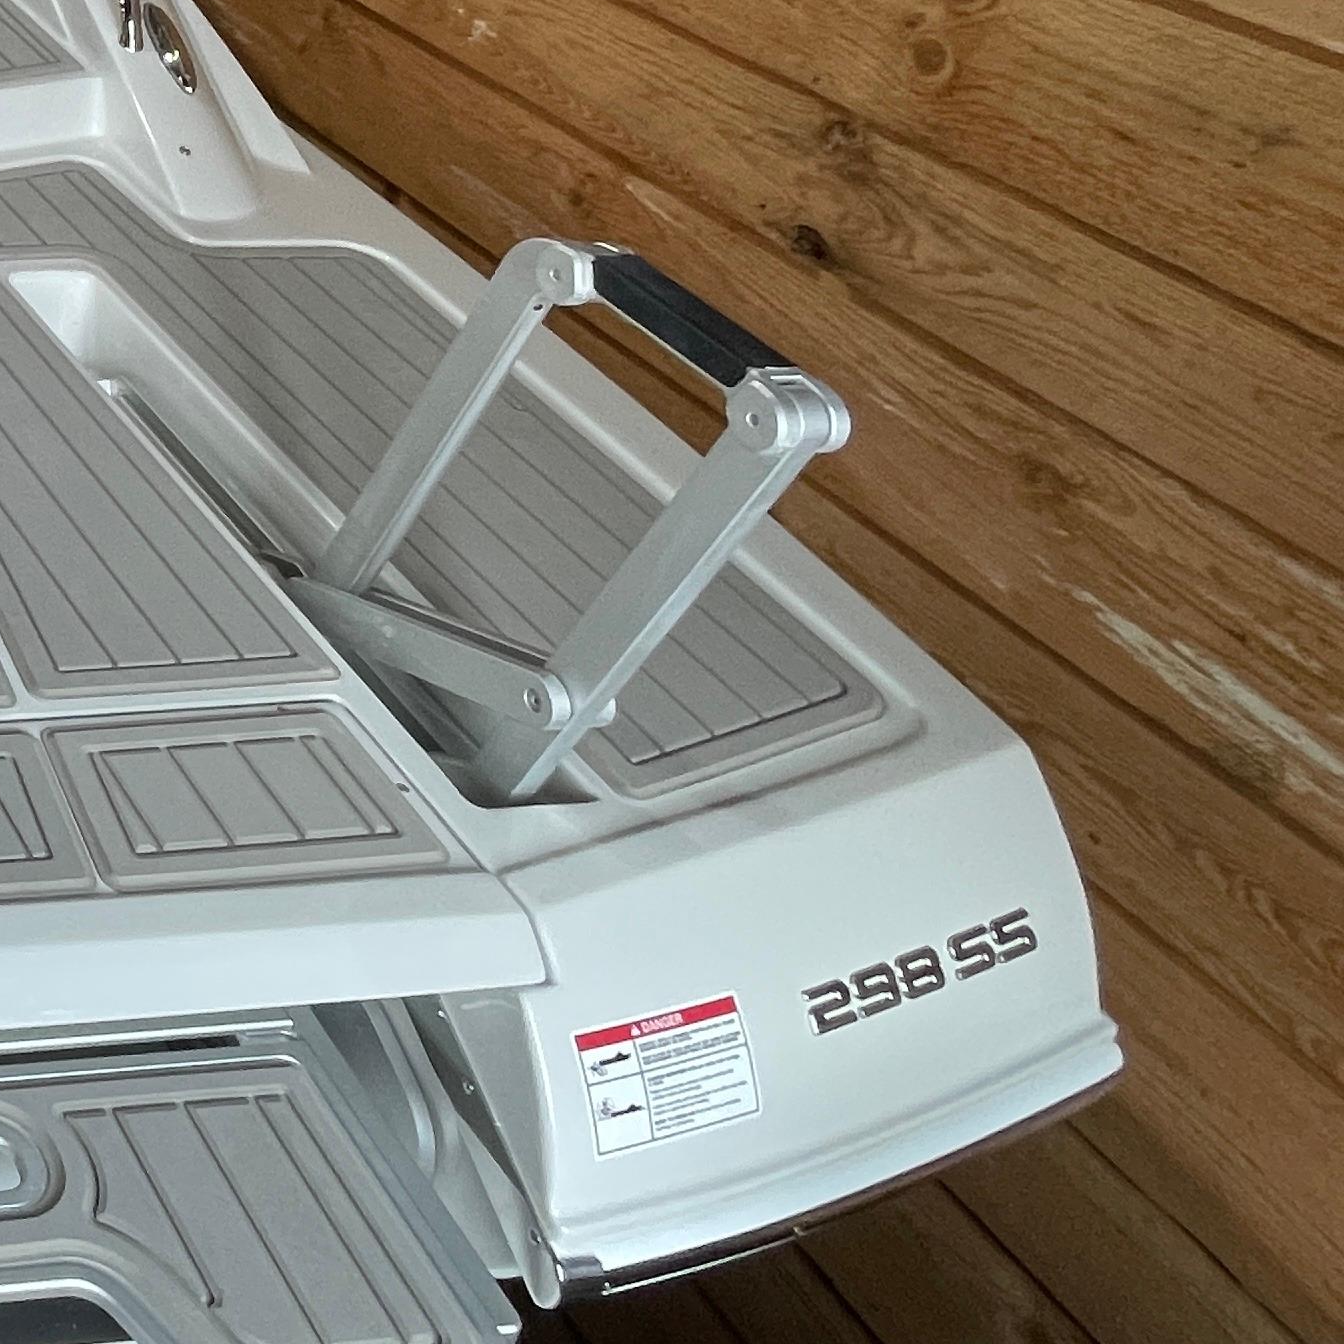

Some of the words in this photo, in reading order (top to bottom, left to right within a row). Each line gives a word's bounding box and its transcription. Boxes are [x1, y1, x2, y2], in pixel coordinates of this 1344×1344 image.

[801, 944, 946, 1036] 298
[946, 906, 1039, 982] SS
[639, 1012, 685, 1034] DANGER
